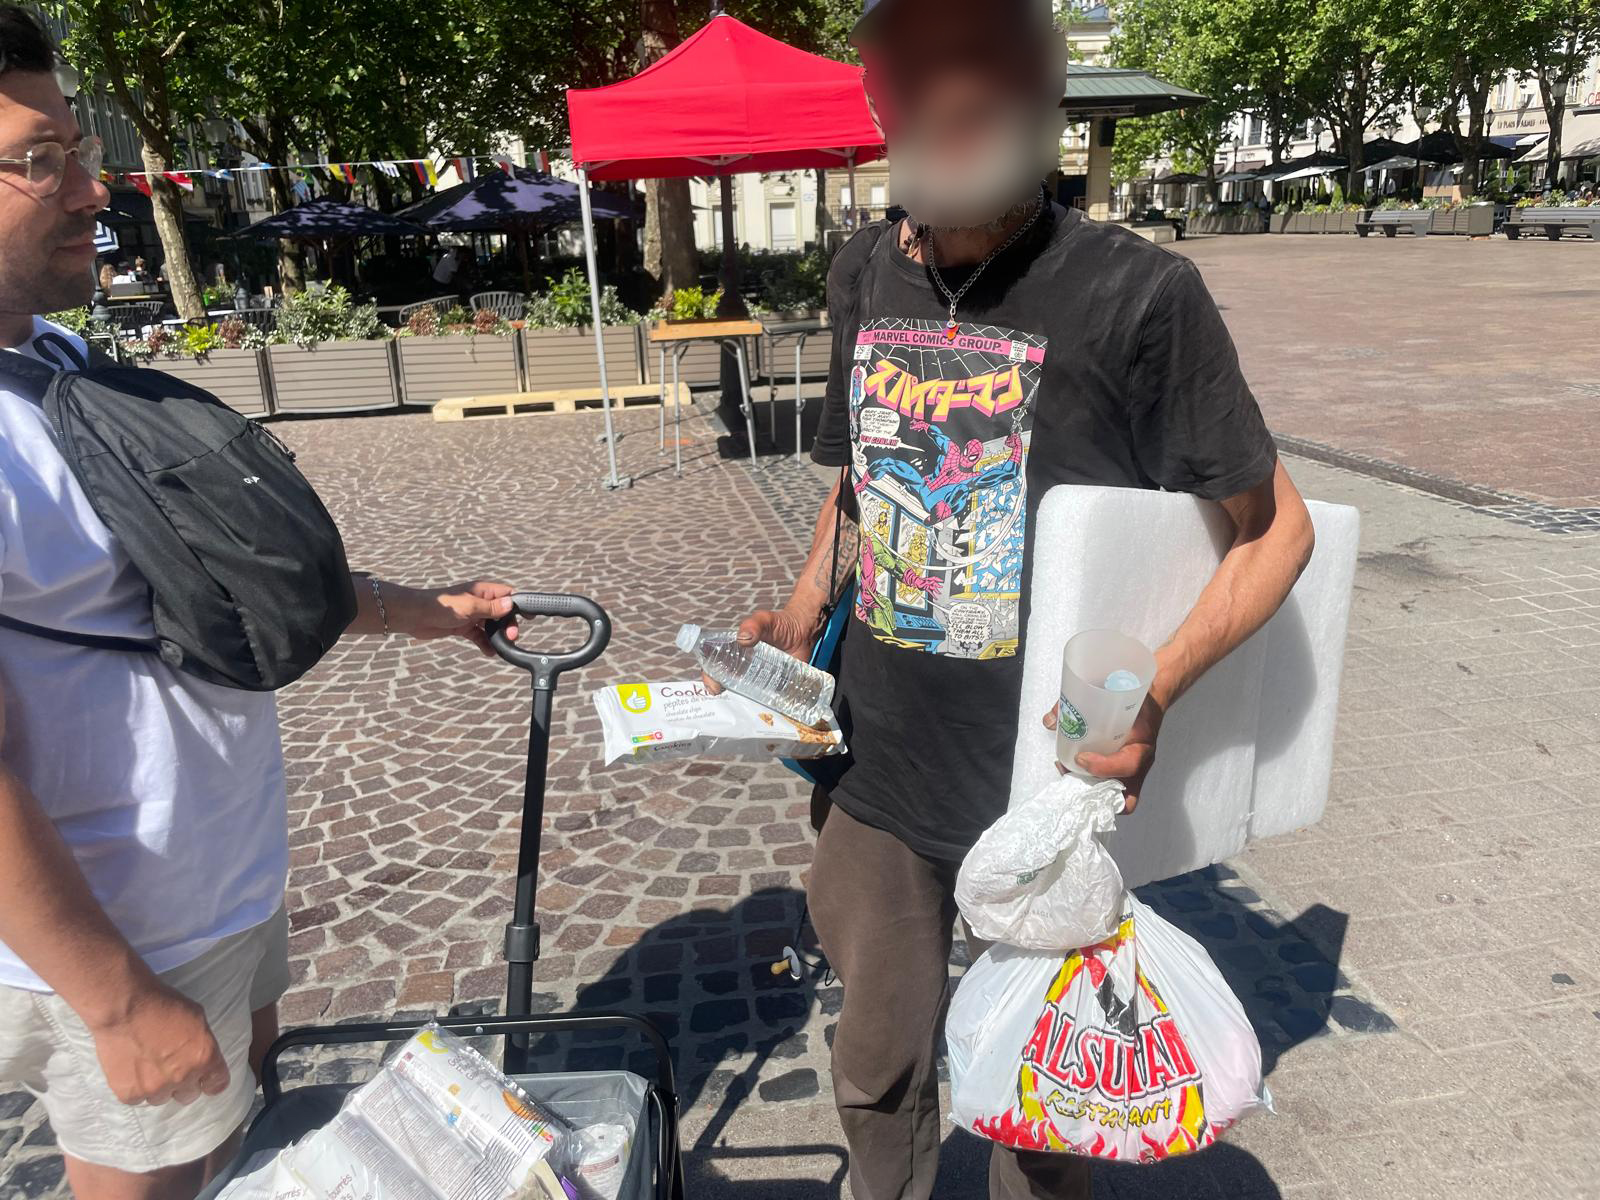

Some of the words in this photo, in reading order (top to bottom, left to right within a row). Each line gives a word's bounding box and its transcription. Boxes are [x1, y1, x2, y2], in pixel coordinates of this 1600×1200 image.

[873, 331, 910, 343] MARVEL
[912, 334, 954, 346] COMICS
[660, 683, 709, 698] Cooki
